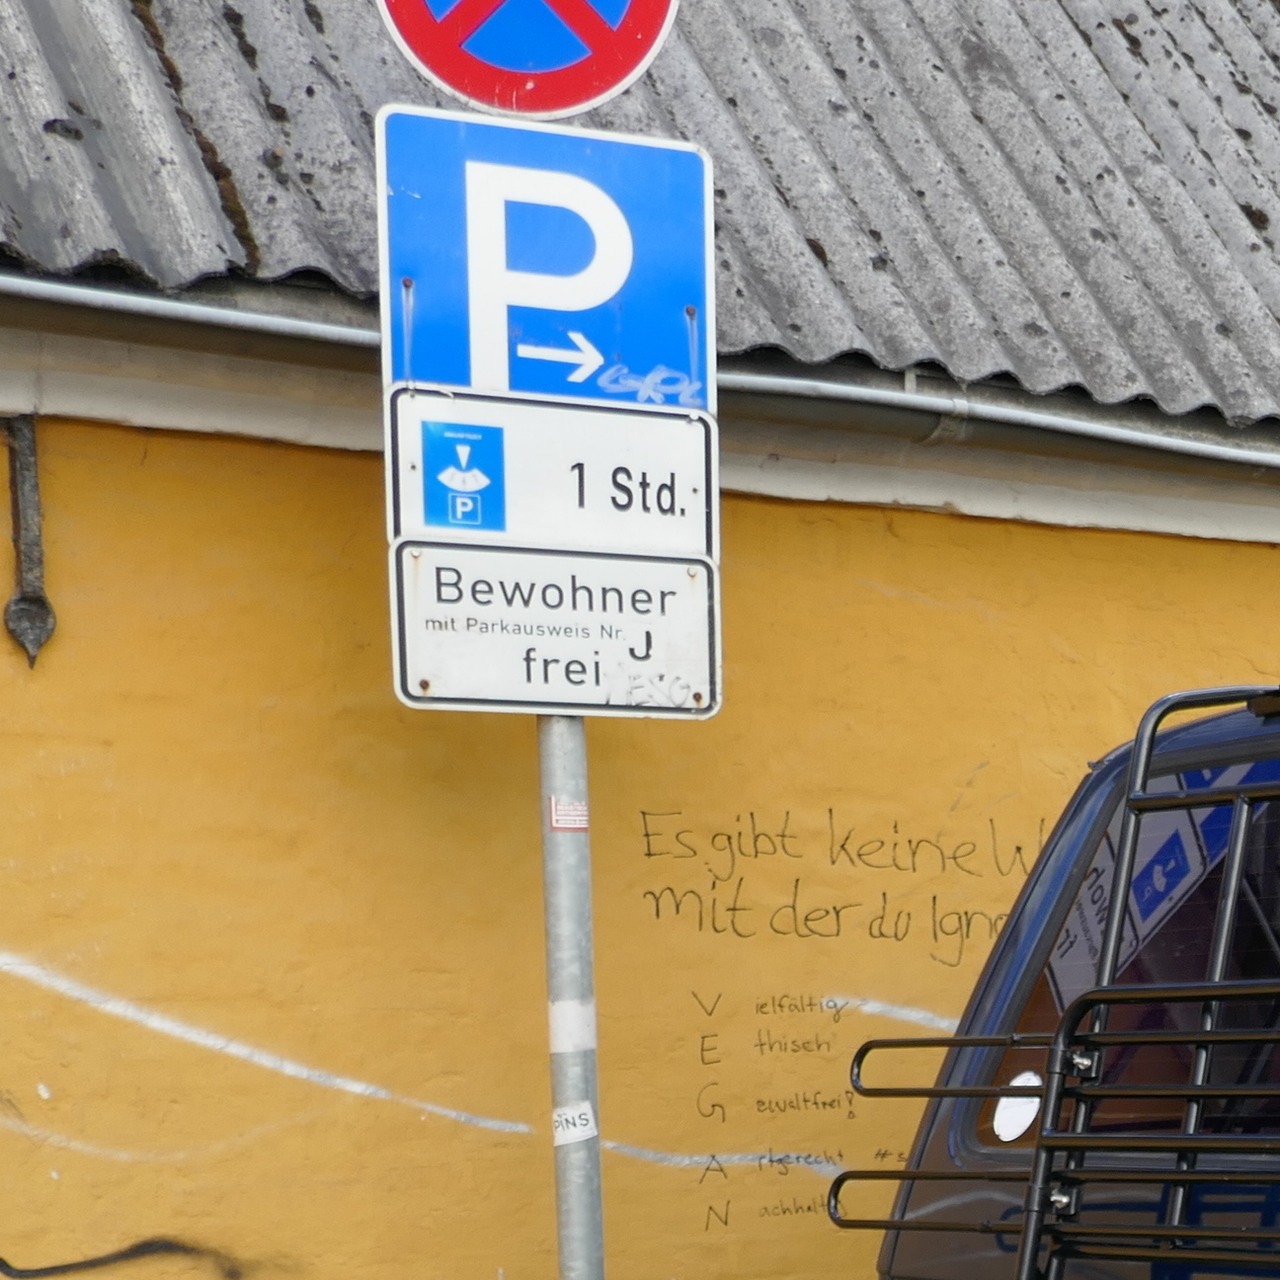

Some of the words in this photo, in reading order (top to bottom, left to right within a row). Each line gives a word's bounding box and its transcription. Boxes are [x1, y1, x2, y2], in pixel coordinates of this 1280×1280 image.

[465, 160, 634, 391] P
[456, 497, 474, 519] P
[570, 462, 586, 509] 1
[610, 466, 686, 517] Std.
[435, 566, 678, 616] Bewohner
[425, 617, 456, 632] mit
[466, 617, 591, 639] Parkausweis
[600, 624, 626, 641] Nr.
[628, 630, 653, 662] J
[522, 647, 601, 687] frei
[640, 810, 698, 859] Es
[704, 810, 803, 883] gibt
[828, 807, 984, 878] keine
[642, 876, 761, 939] mit
[768, 877, 863, 939] der
[691, 990, 722, 1017] V
[700, 1033, 721, 1066] E
[699, 1154, 728, 1185] A
[704, 1200, 731, 1233] N
